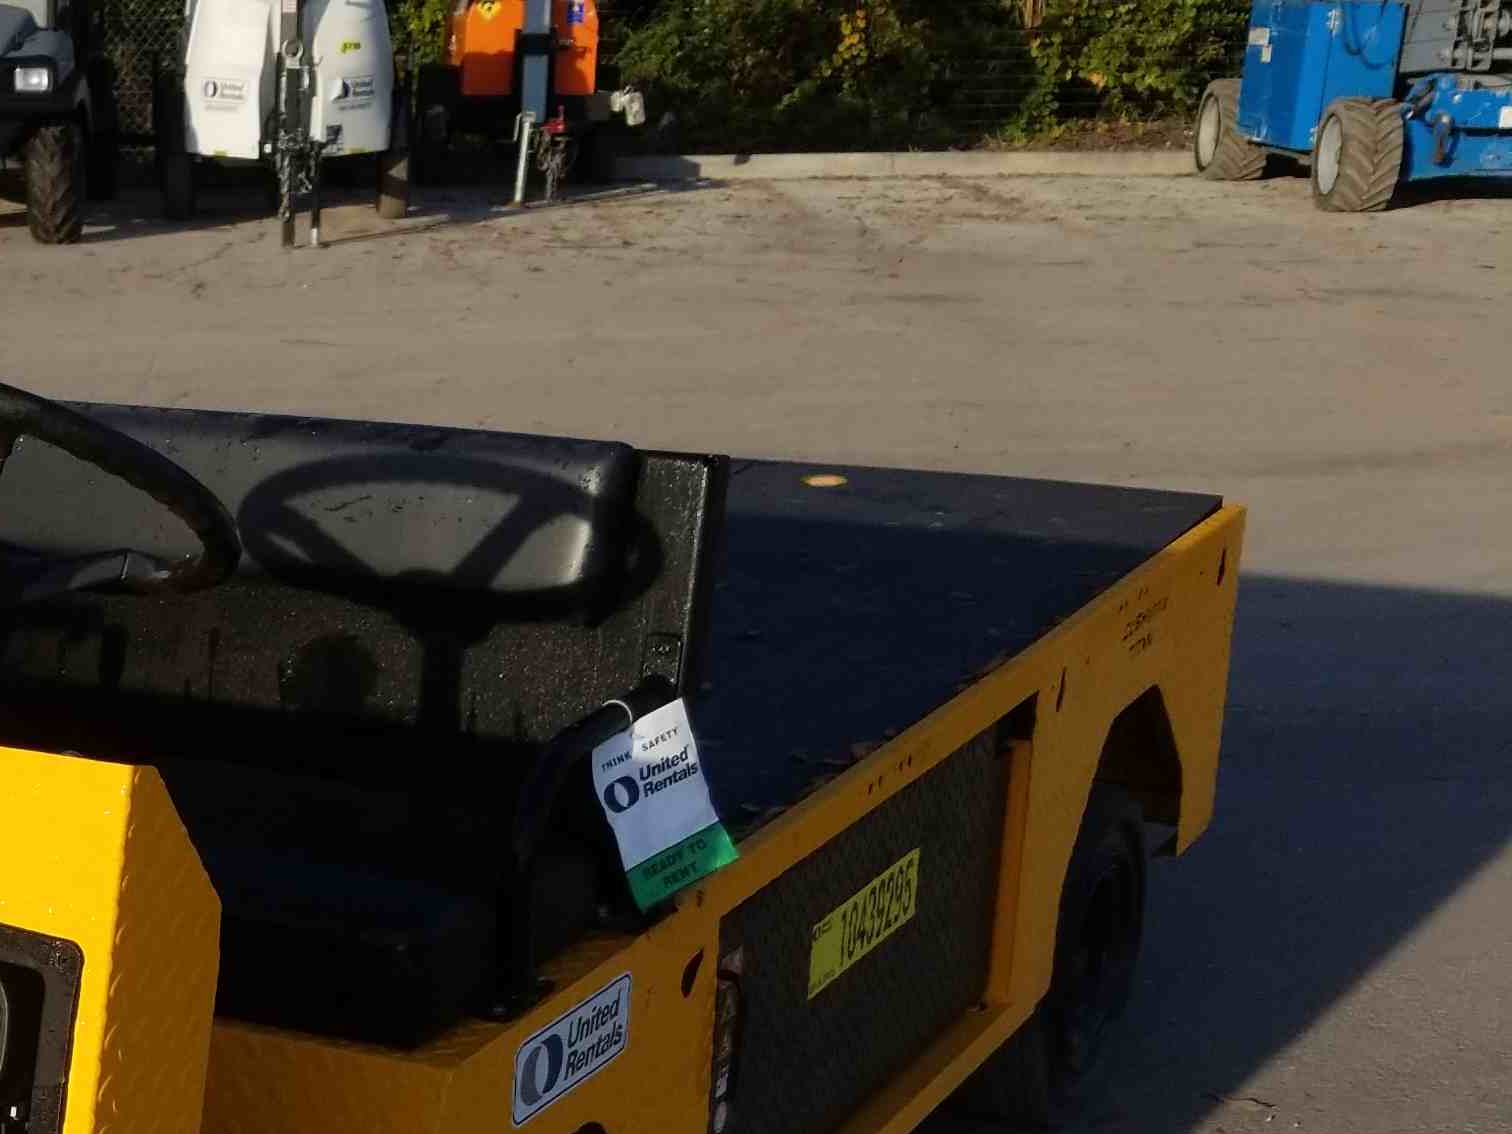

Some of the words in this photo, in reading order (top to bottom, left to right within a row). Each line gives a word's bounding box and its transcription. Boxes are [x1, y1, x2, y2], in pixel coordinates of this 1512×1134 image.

[601, 752, 633, 773] THINK
[641, 726, 680, 752] SAFETY
[639, 745, 690, 781] United
[643, 760, 699, 798] Rentals
[644, 849, 685, 879] READY
[688, 837, 707, 854] TO
[663, 861, 698, 888] RENT
[567, 991, 622, 1049] United
[563, 1021, 623, 1081] Rentals
